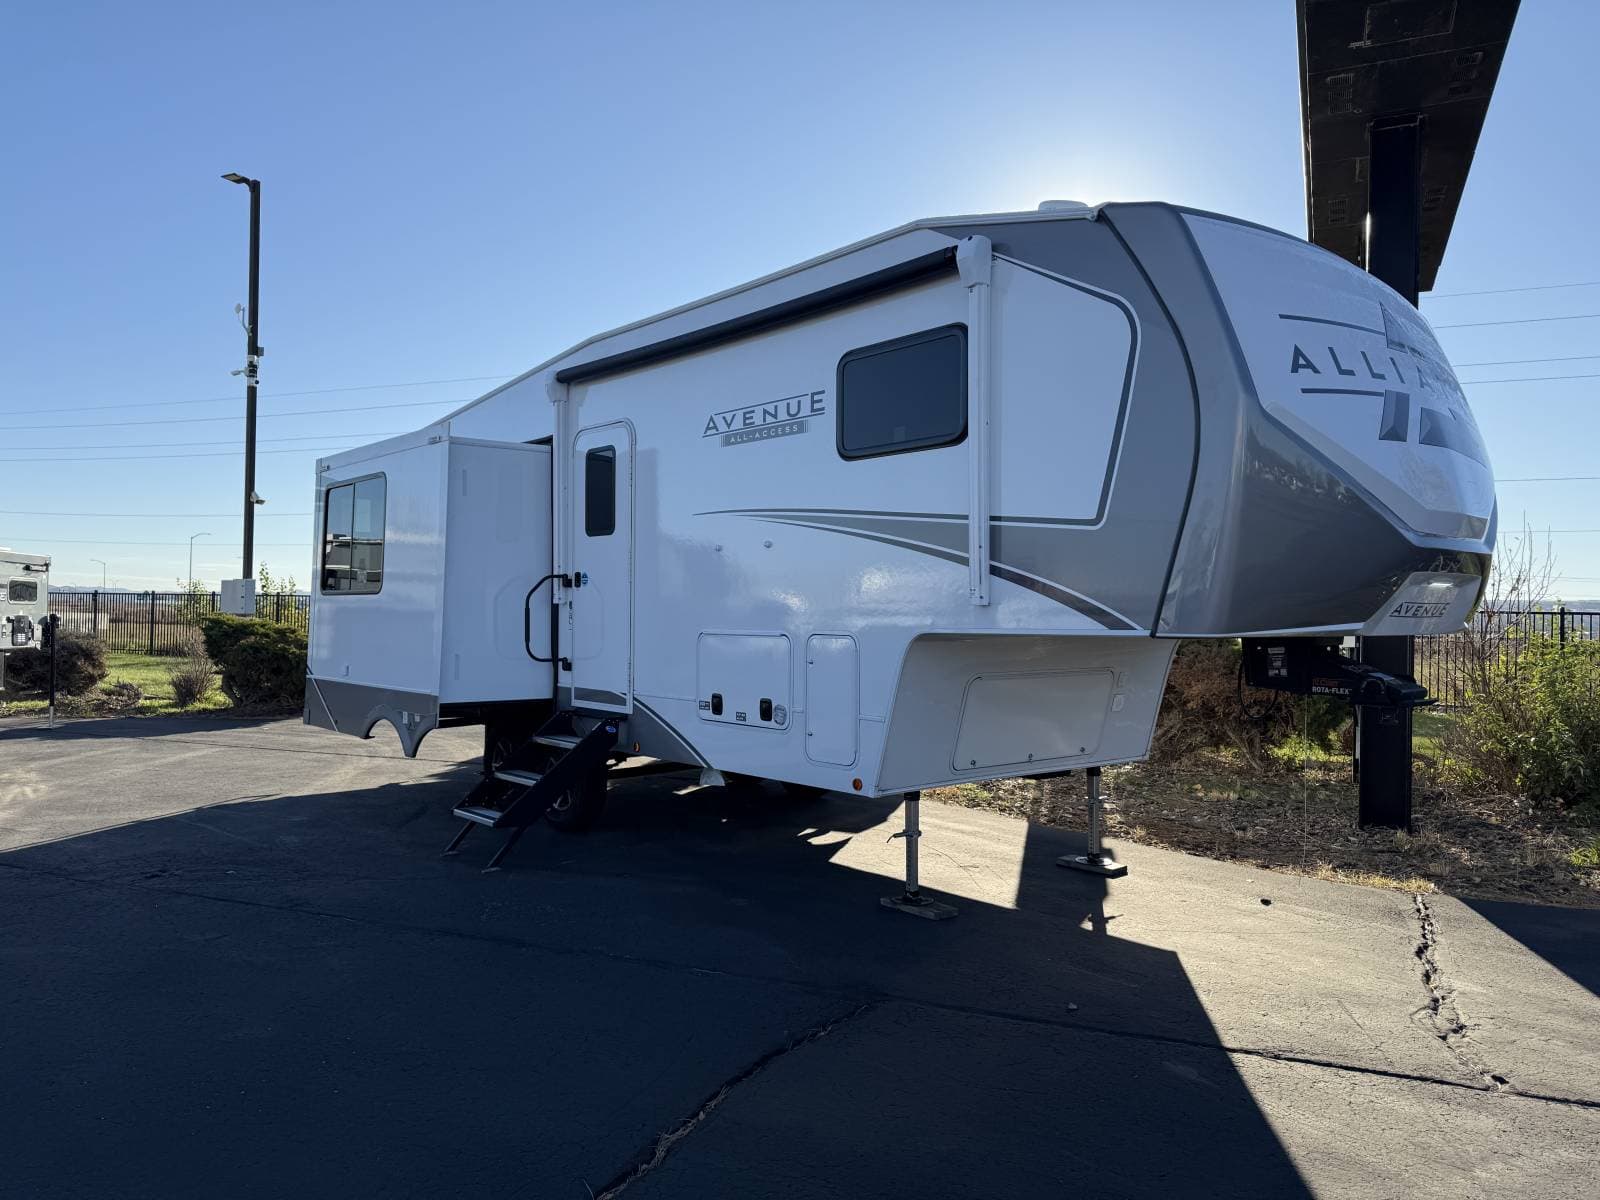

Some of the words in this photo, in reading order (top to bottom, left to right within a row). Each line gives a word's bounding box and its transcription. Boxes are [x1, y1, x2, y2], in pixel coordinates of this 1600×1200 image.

[703, 389, 826, 435] AVENUE
[729, 424, 799, 443] ALL-ACCESS
[1391, 602, 1450, 616] AVENUE
